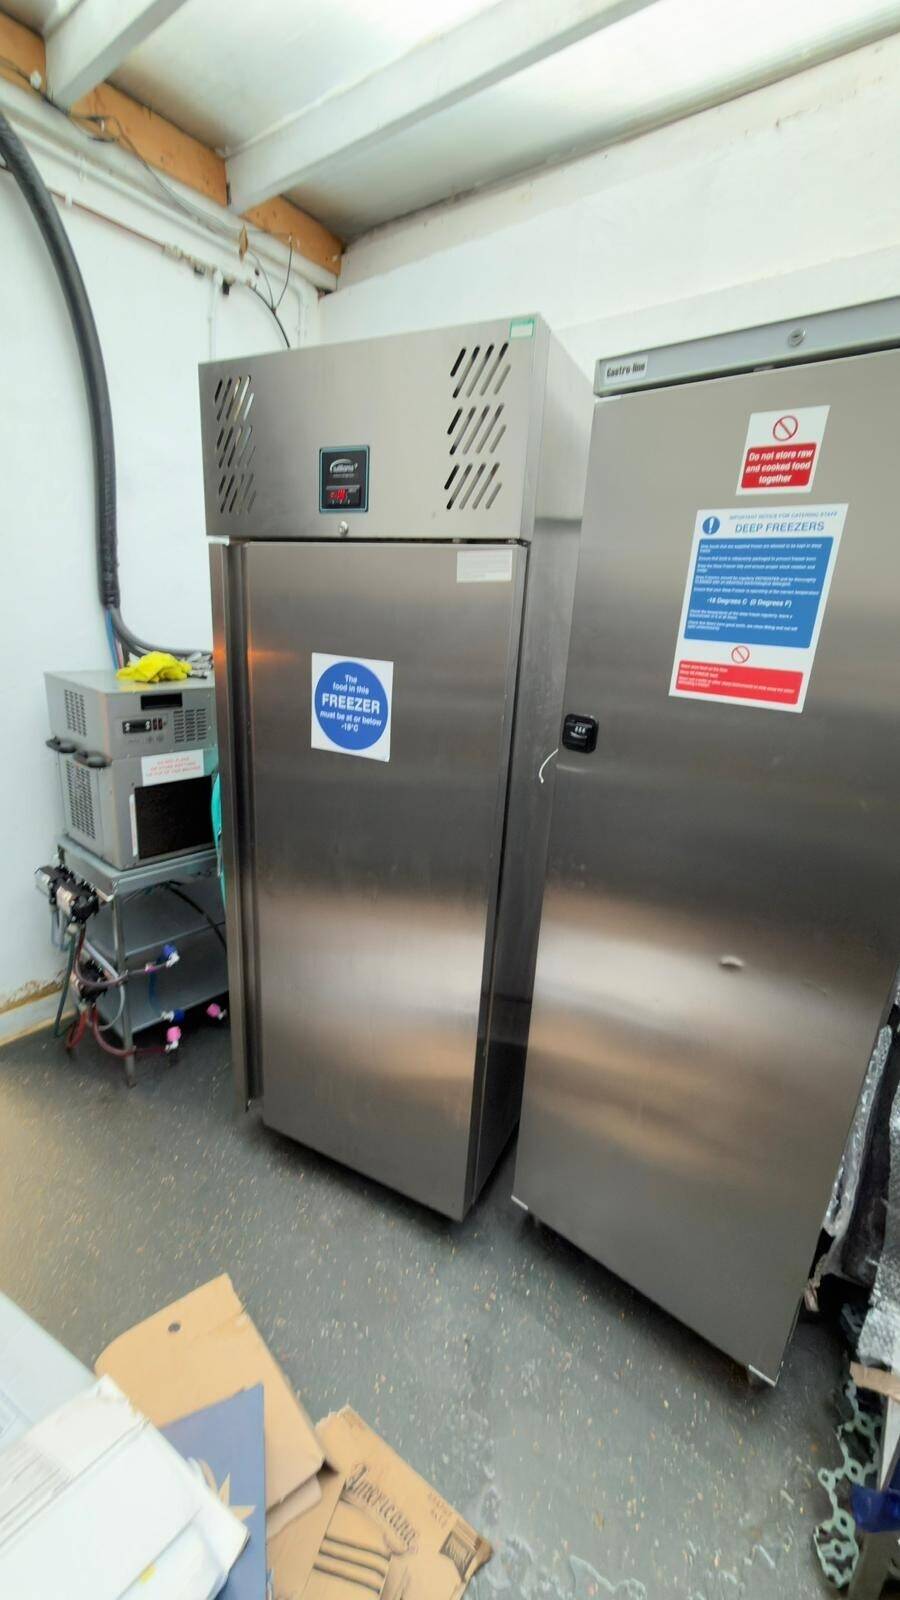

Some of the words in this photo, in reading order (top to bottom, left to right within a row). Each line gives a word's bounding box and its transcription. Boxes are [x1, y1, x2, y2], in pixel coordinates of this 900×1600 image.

[749, 452, 759, 461] Do
[761, 451, 774, 460] not
[775, 451, 796, 459] store
[797, 450, 813, 458] raw
[746, 464, 760, 473] and
[761, 462, 791, 472] cooked
[792, 461, 811, 470] food
[758, 474, 792, 485] together
[735, 522, 763, 533] DEEP
[765, 520, 825, 532] FREEZERS
[345, 674, 358, 683] The
[333, 682, 347, 691] food
[348, 684, 355, 692] in
[357, 685, 369, 695] this
[321, 693, 380, 714] FREEZER
[320, 710, 335, 719] must
[337, 711, 345, 720] be
[346, 713, 352, 721] at
[353, 715, 360, 723] or
[362, 716, 382, 727] below
